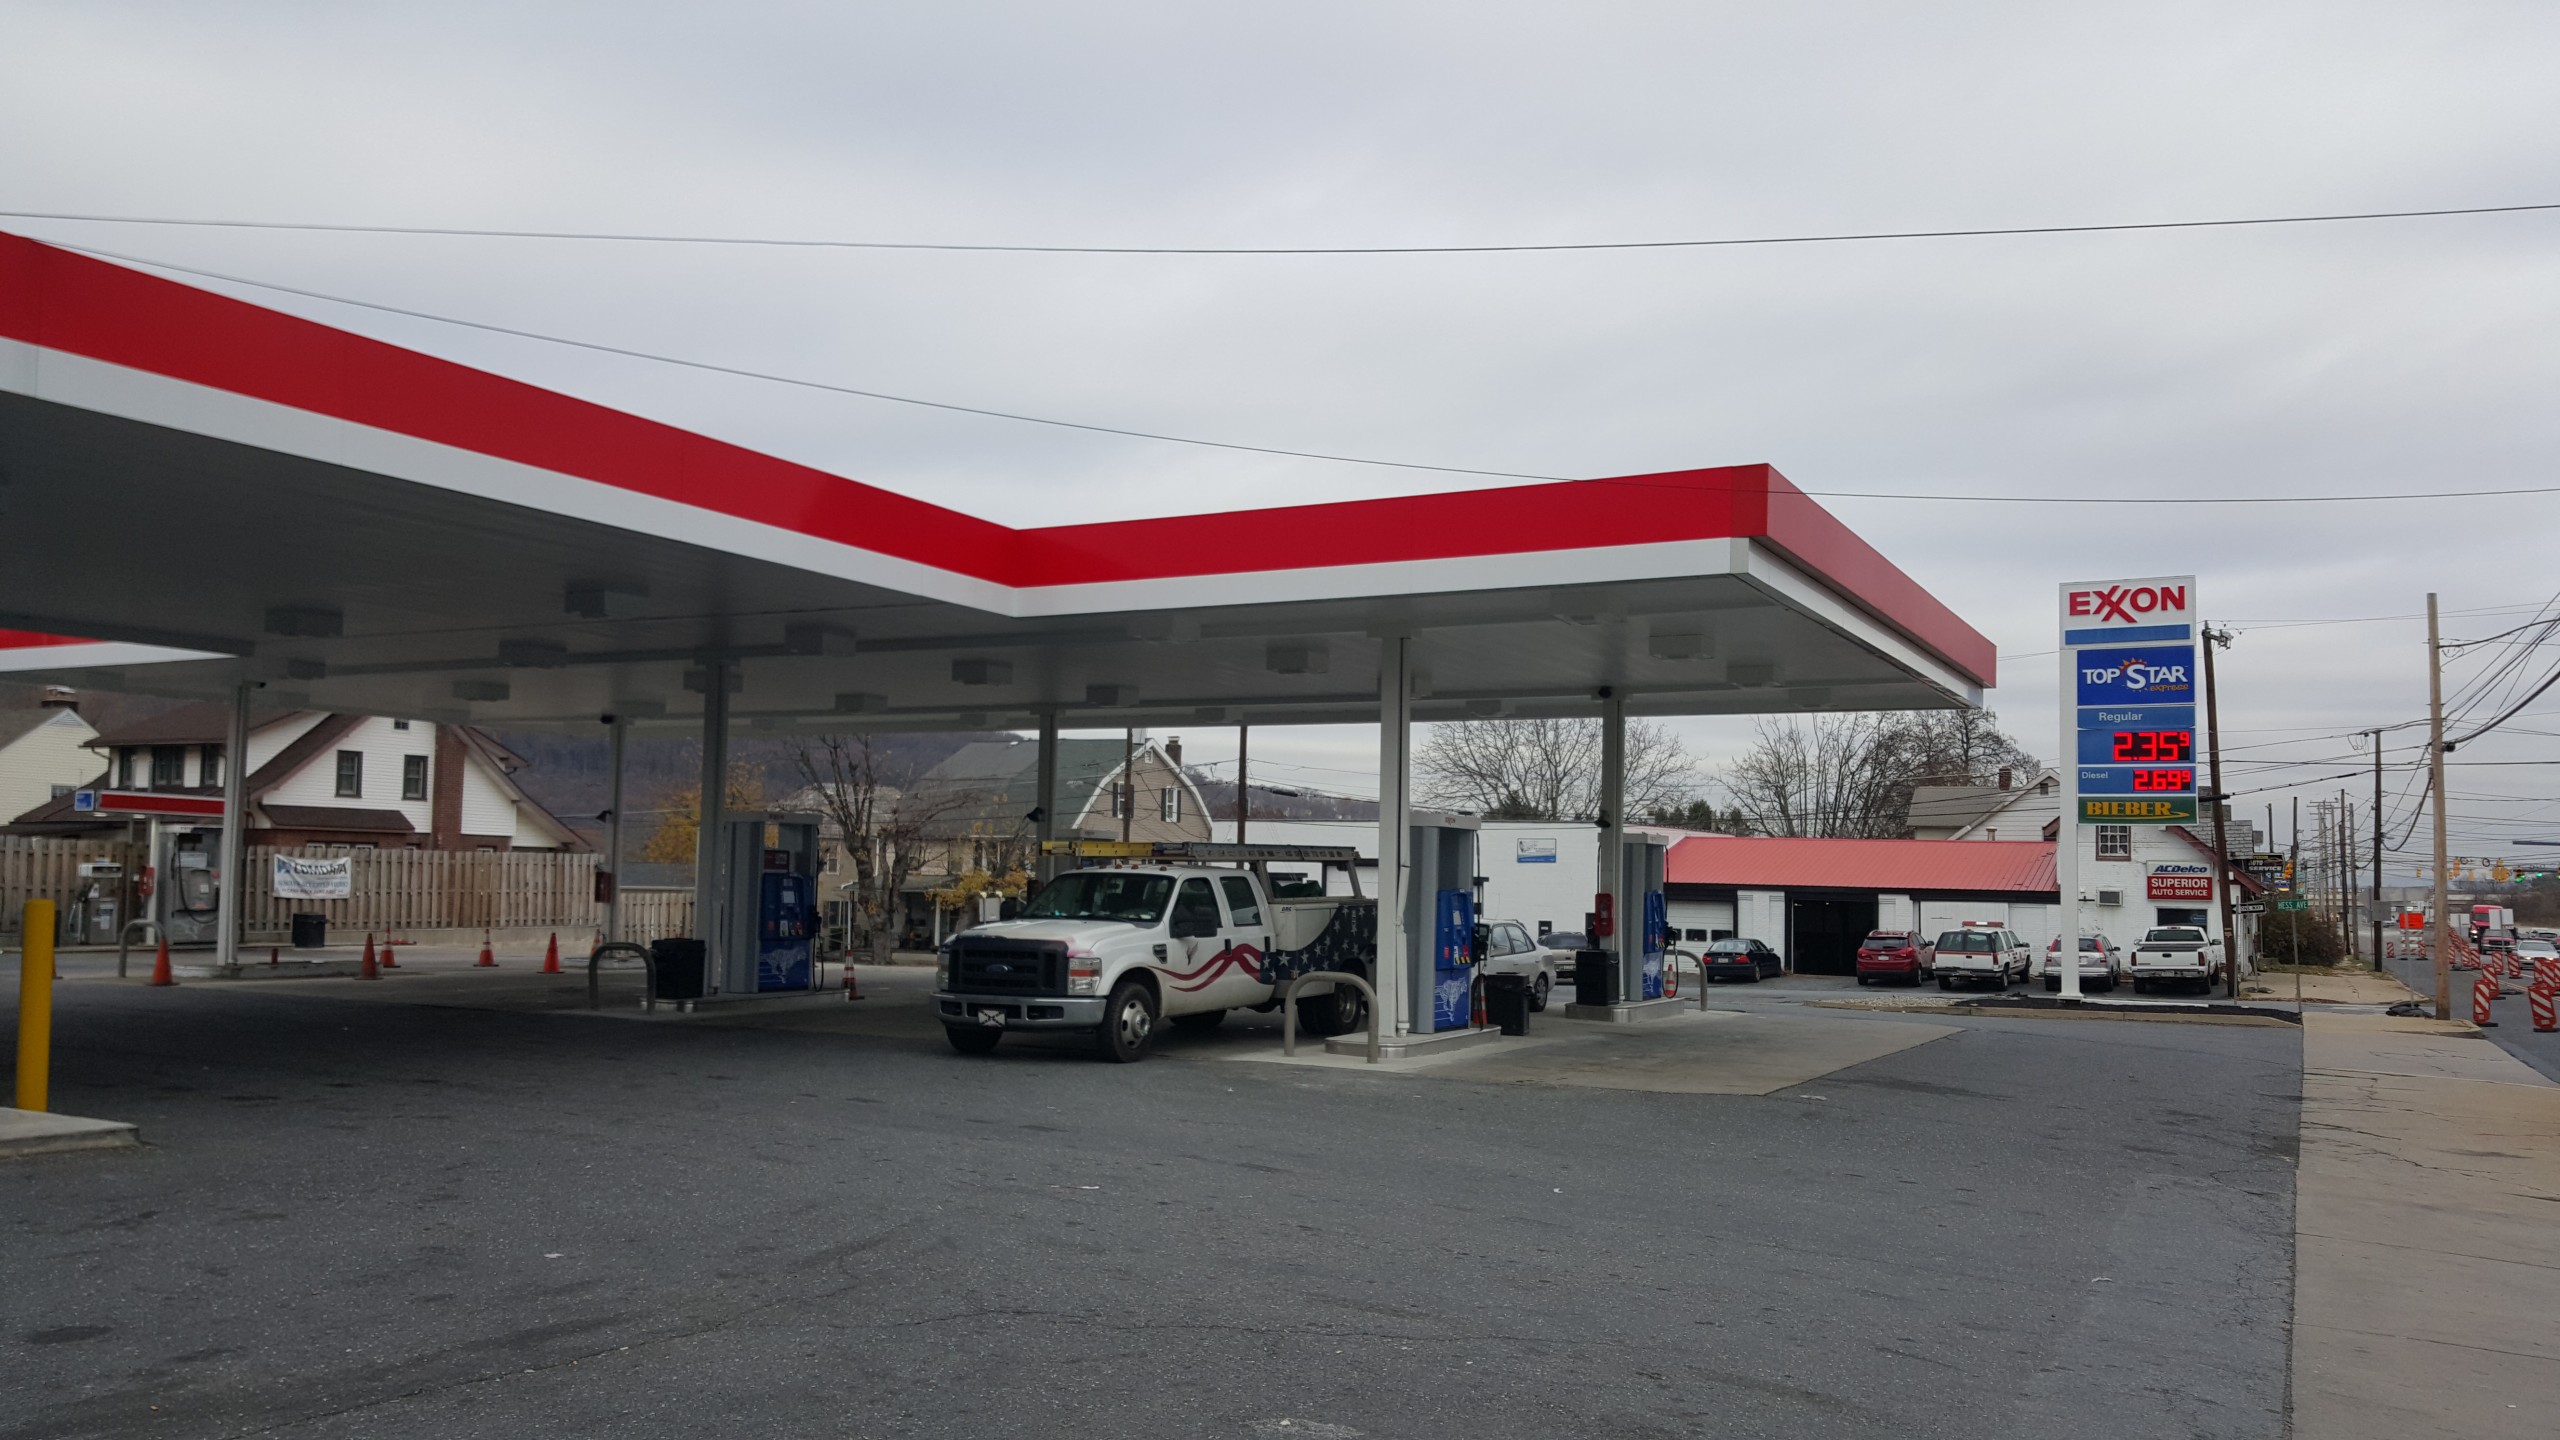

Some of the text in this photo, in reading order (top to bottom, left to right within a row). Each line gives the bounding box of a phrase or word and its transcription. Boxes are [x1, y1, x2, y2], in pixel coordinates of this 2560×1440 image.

[2069, 585, 2185, 623] EXXON
[2082, 663, 2188, 690] TOP STAR
[2099, 712, 2143, 722] Regular
[2081, 771, 2109, 779] Diesel
[2086, 801, 2172, 816] BIEBER
[2154, 865, 2207, 873] ACDelco
[2151, 878, 2208, 888] SUPERIOR
[2296, 900, 2308, 909] AVE
